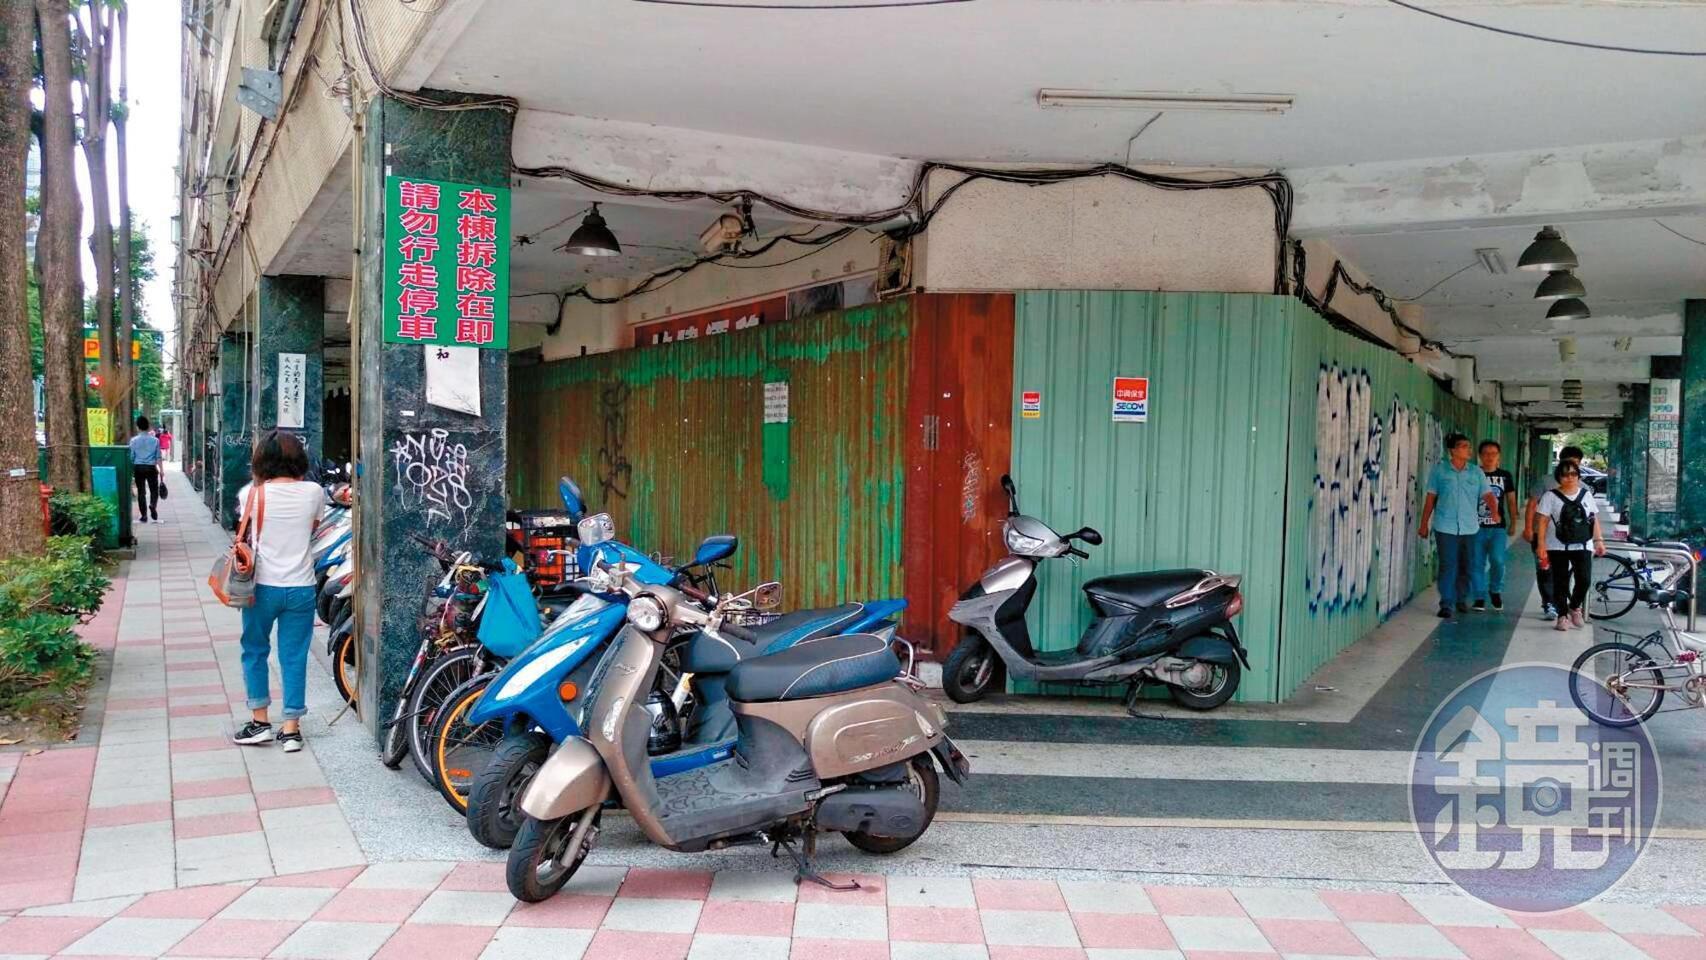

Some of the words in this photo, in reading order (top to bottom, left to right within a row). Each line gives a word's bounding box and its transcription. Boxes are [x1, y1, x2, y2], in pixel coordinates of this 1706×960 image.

[397, 180, 440, 341] 請勿行走停車
[455, 188, 497, 345] 本棟拆除在即
[1116, 402, 1144, 411] SECOM
